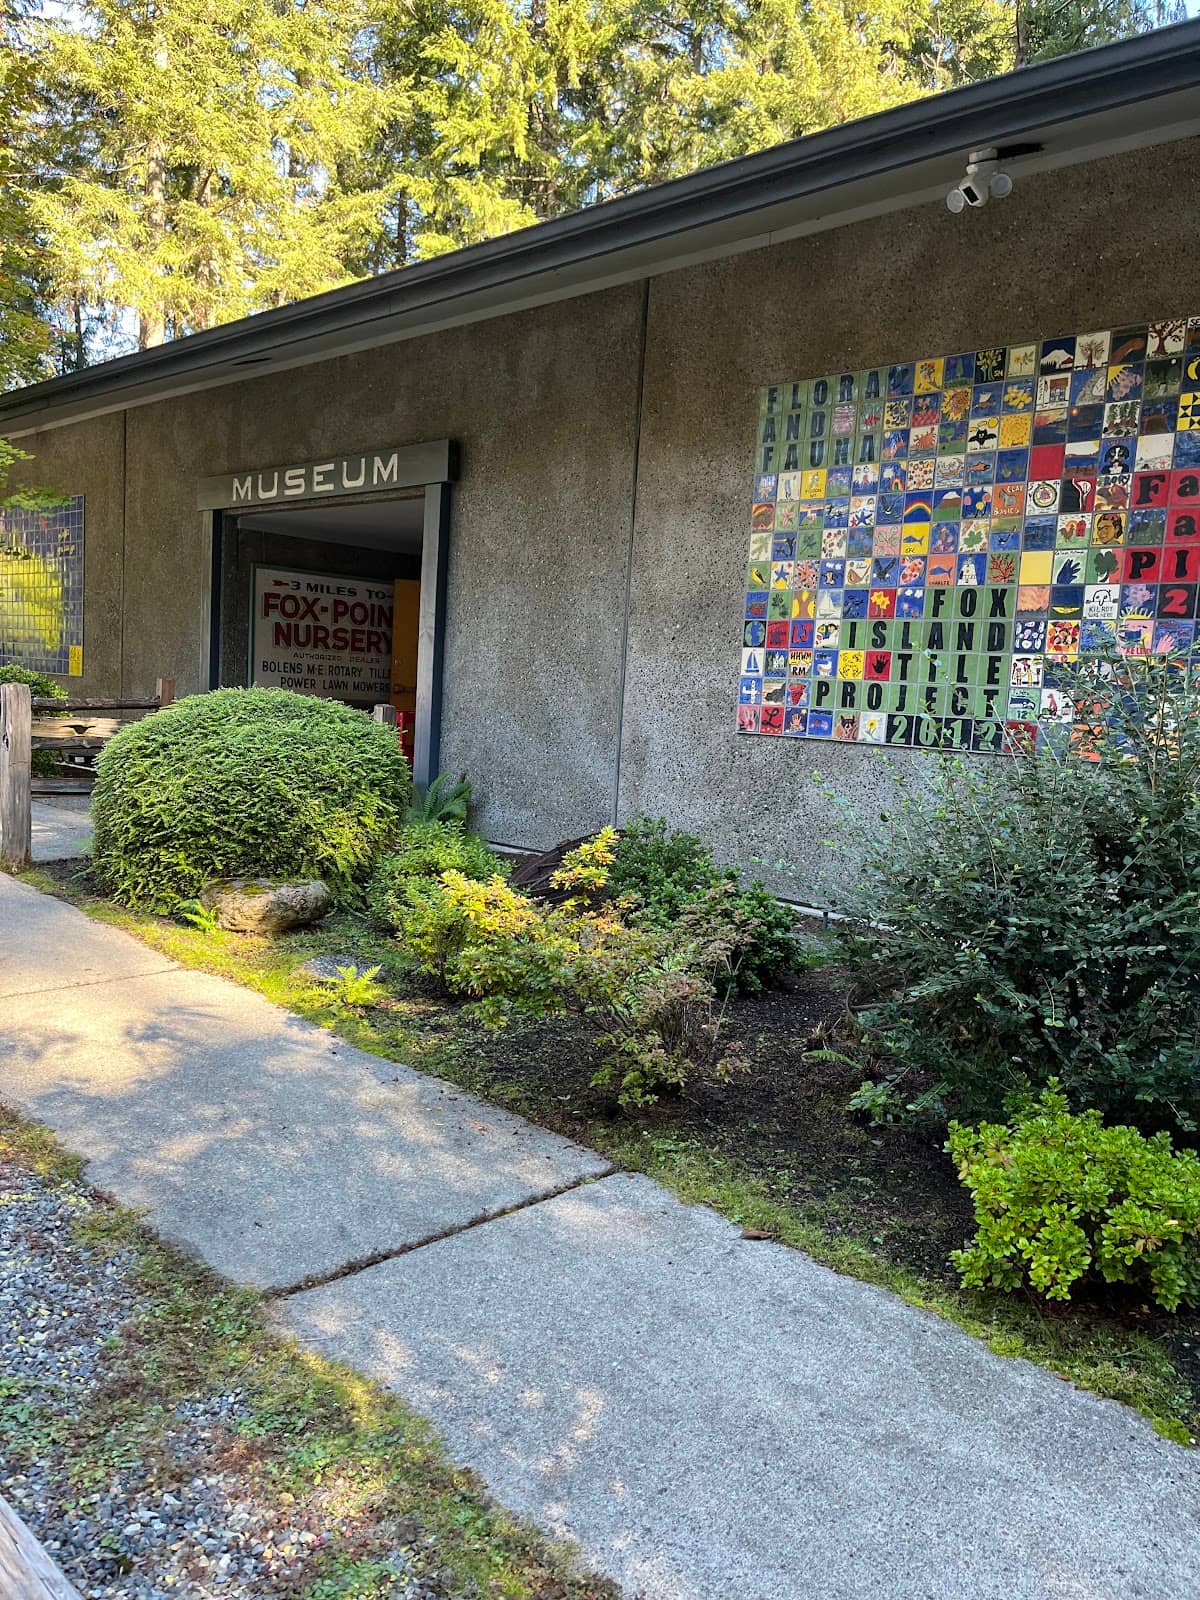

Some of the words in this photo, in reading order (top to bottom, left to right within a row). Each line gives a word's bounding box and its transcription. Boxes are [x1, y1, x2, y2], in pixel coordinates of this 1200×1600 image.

[766, 370, 881, 414] FLORA
[762, 411, 826, 443] AND
[761, 434, 876, 473] FAUNA
[232, 453, 399, 501] MUSEUM
[290, 580, 301, 591] 3
[306, 582, 357, 597] MILES
[931, 587, 1009, 618] FOX
[263, 592, 394, 628] FOX-POIN
[274, 621, 393, 655] NURSERY
[848, 621, 1006, 652] ISLAND
[262, 660, 303, 674] BOLENS
[328, 665, 363, 678] ROTARY
[293, 652, 342, 661] AUTHORIZED
[349, 656, 381, 664] DEALER
[897, 653, 1002, 684] TILE
[280, 677, 317, 689] POWER
[322, 679, 349, 691] LAWN
[352, 681, 391, 693] MOWERS
[816, 680, 999, 718] PROJECT
[890, 715, 997, 750] 2012
